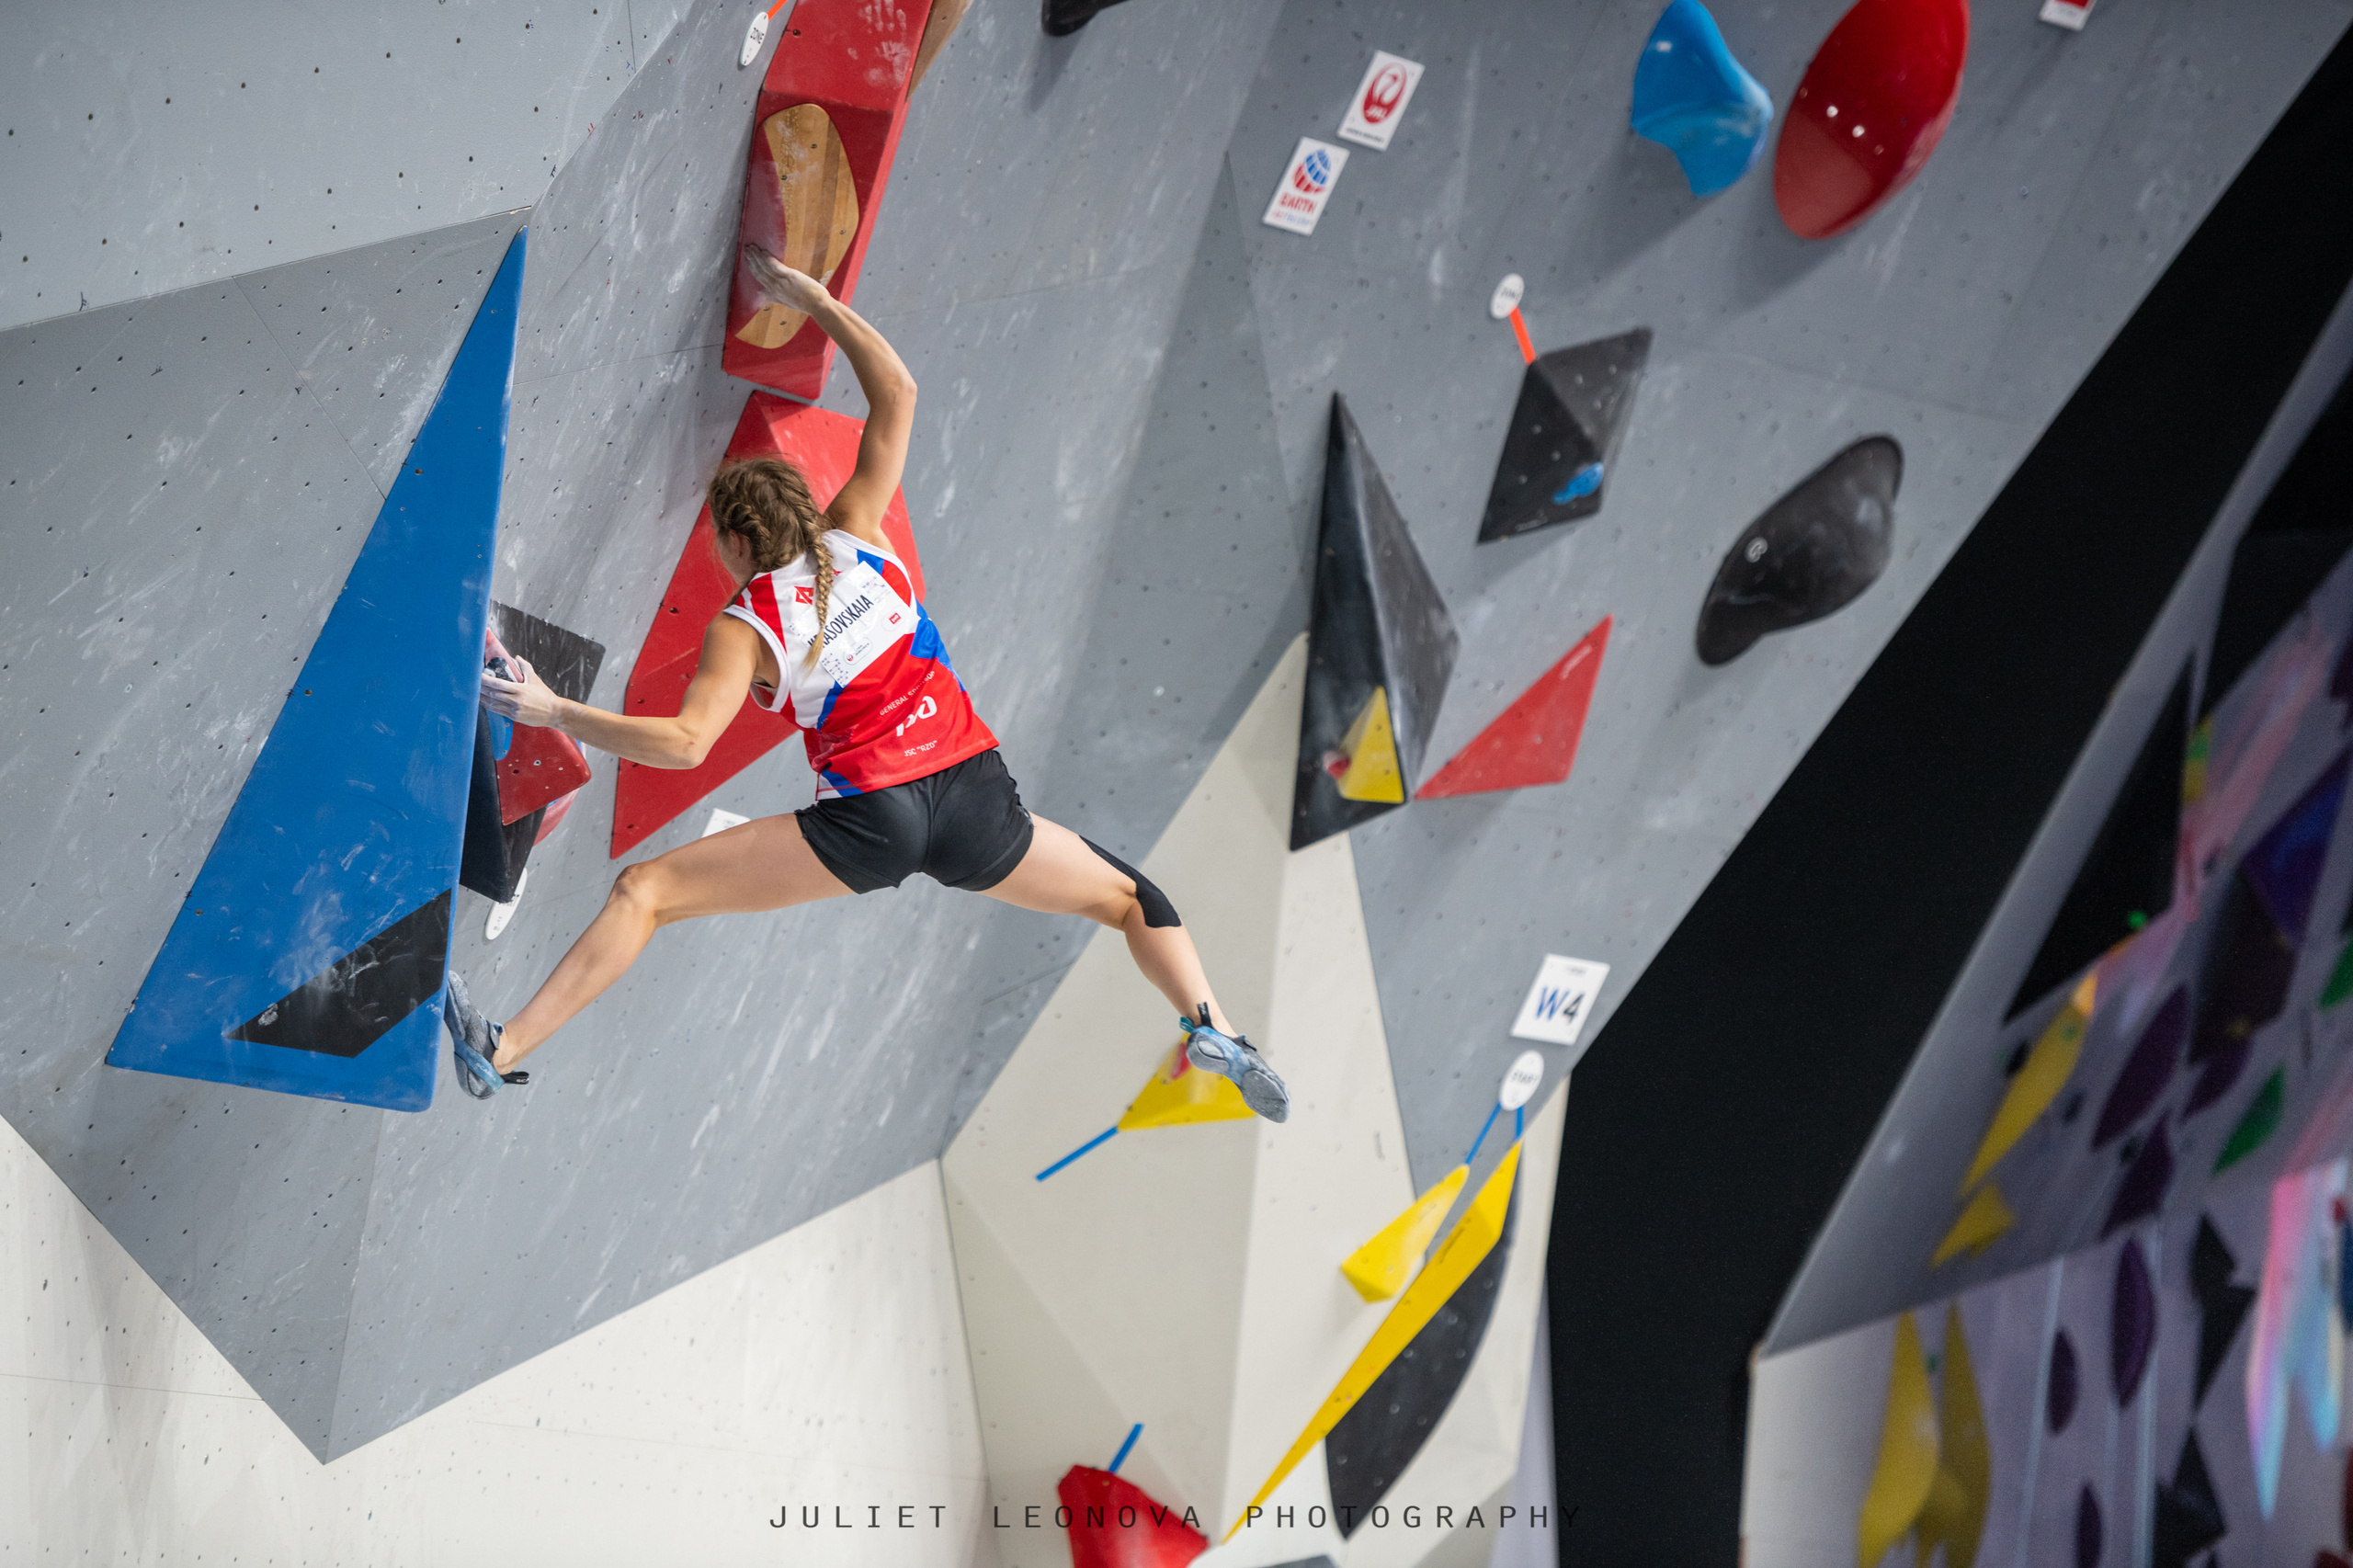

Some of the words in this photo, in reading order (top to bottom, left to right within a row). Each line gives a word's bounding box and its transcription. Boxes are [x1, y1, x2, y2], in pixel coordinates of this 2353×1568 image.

[880, 695, 908, 715] GENERAL
[904, 748, 917, 757] JSC
[1536, 985, 1586, 1025] W4
